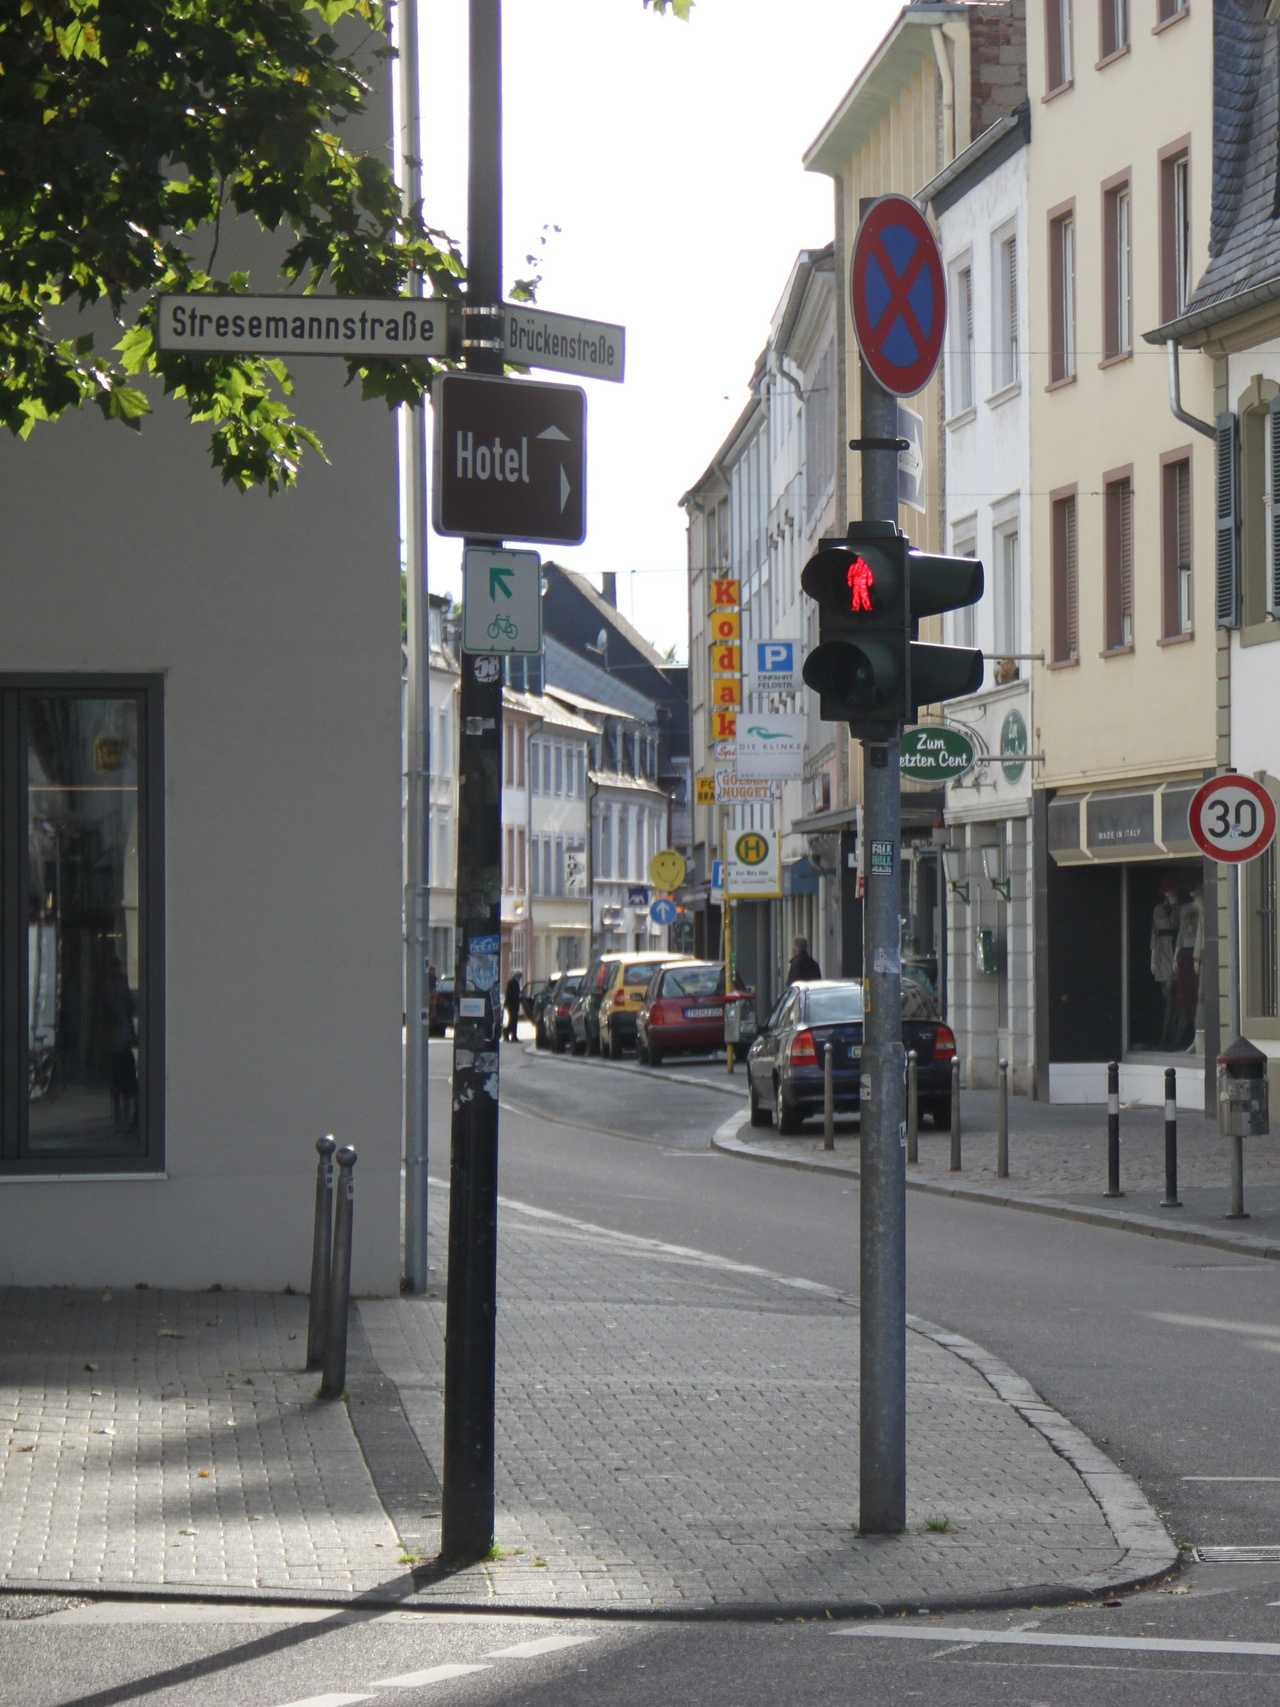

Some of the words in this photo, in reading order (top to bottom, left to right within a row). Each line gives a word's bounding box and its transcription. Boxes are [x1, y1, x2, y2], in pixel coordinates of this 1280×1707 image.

[172, 305, 435, 342] Stresemannstraße
[509, 317, 614, 367] Brückenstraße
[456, 430, 530, 484] Hotel
[714, 581, 737, 736] Kodak
[765, 645, 787, 671] P
[917, 734, 946, 750] Zum
[900, 752, 939, 767] etzten
[939, 750, 969, 767] Cent
[722, 786, 769, 798] NUGGET
[1208, 799, 1257, 838] 30
[1098, 831, 1114, 840] MADE
[1124, 829, 1141, 838] ITALY
[744, 840, 760, 858] H
